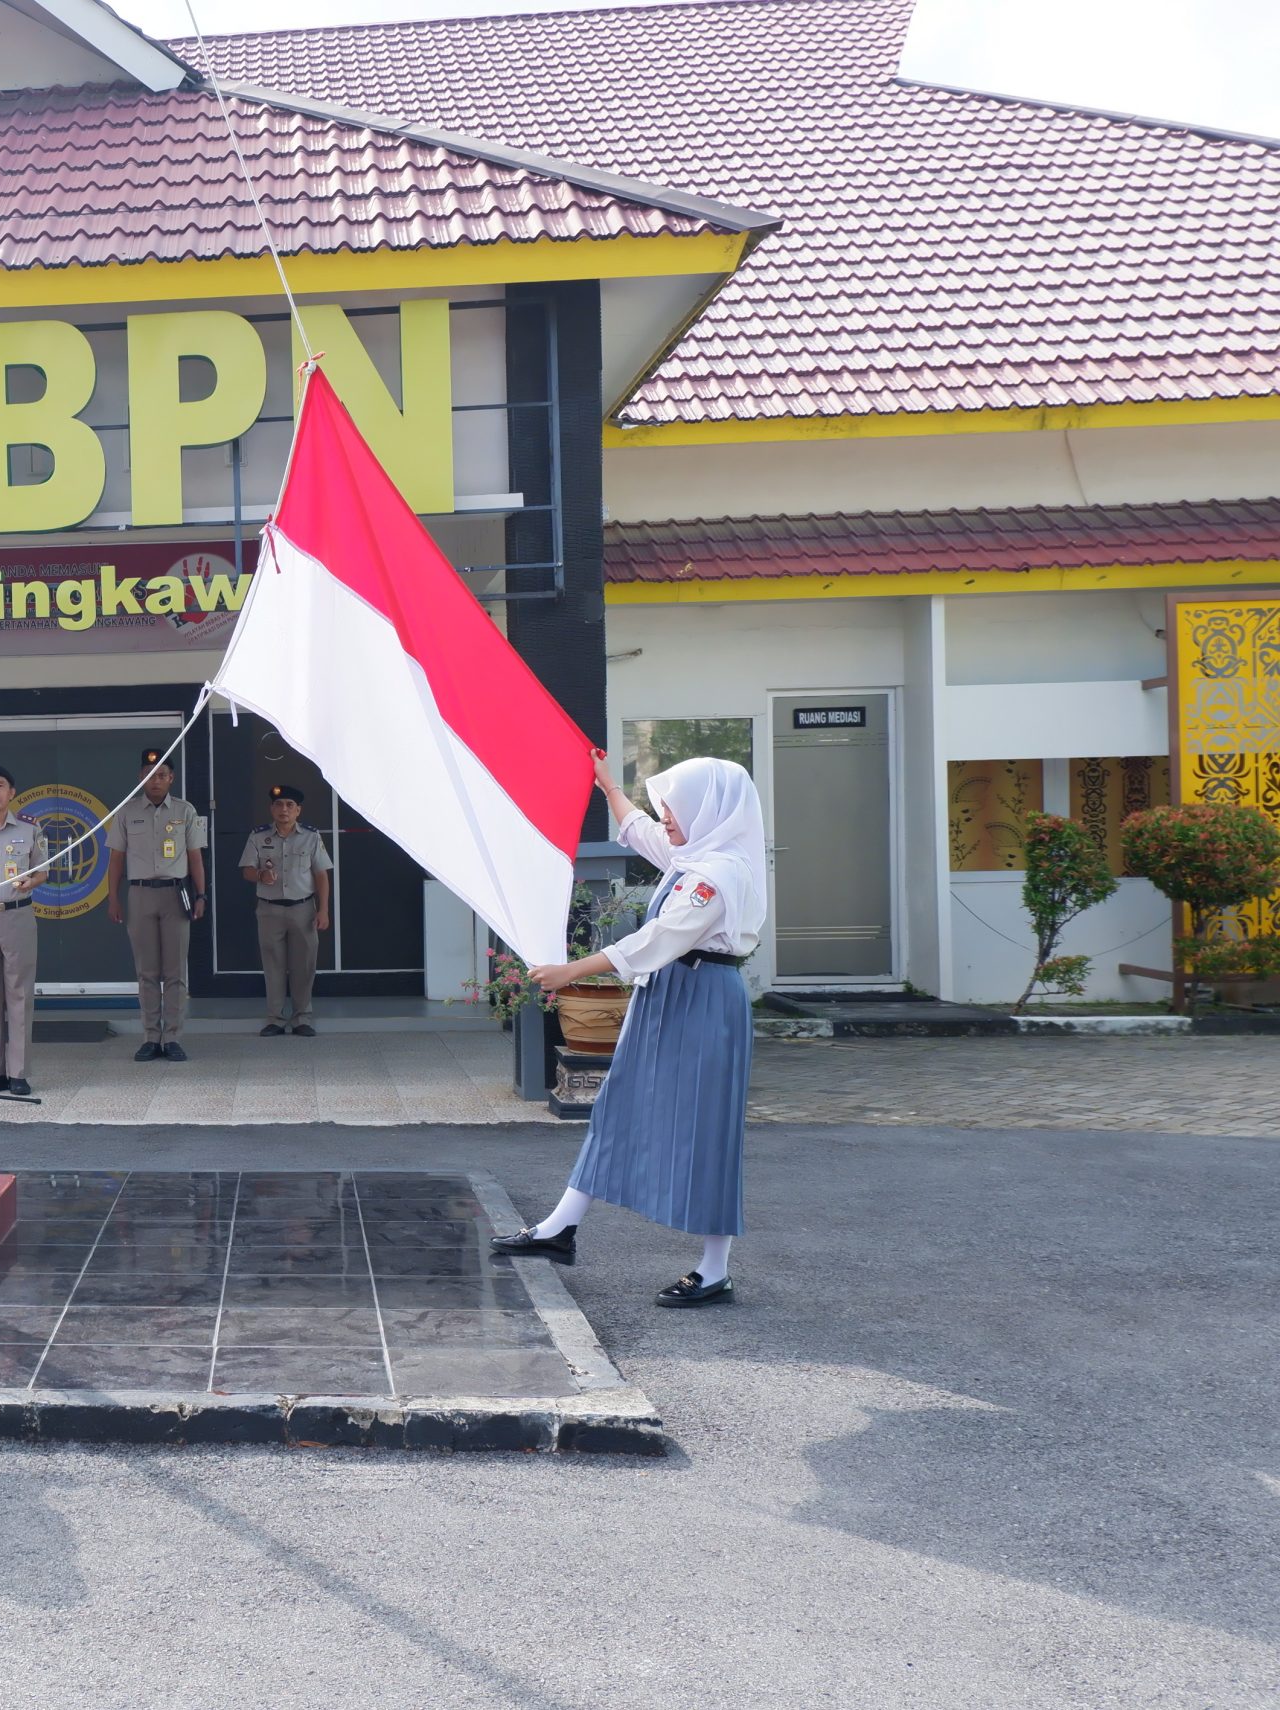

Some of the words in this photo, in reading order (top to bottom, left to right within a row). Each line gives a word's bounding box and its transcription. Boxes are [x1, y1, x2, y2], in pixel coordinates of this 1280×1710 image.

[94, 616, 157, 629] INGKAWANG
[798, 712, 827, 725] RUANG
[828, 711, 861, 724] MEDIASI
[16, 789, 45, 806] Kantor
[46, 787, 93, 805] Pertanahan
[42, 901, 91, 918] Singkawang
